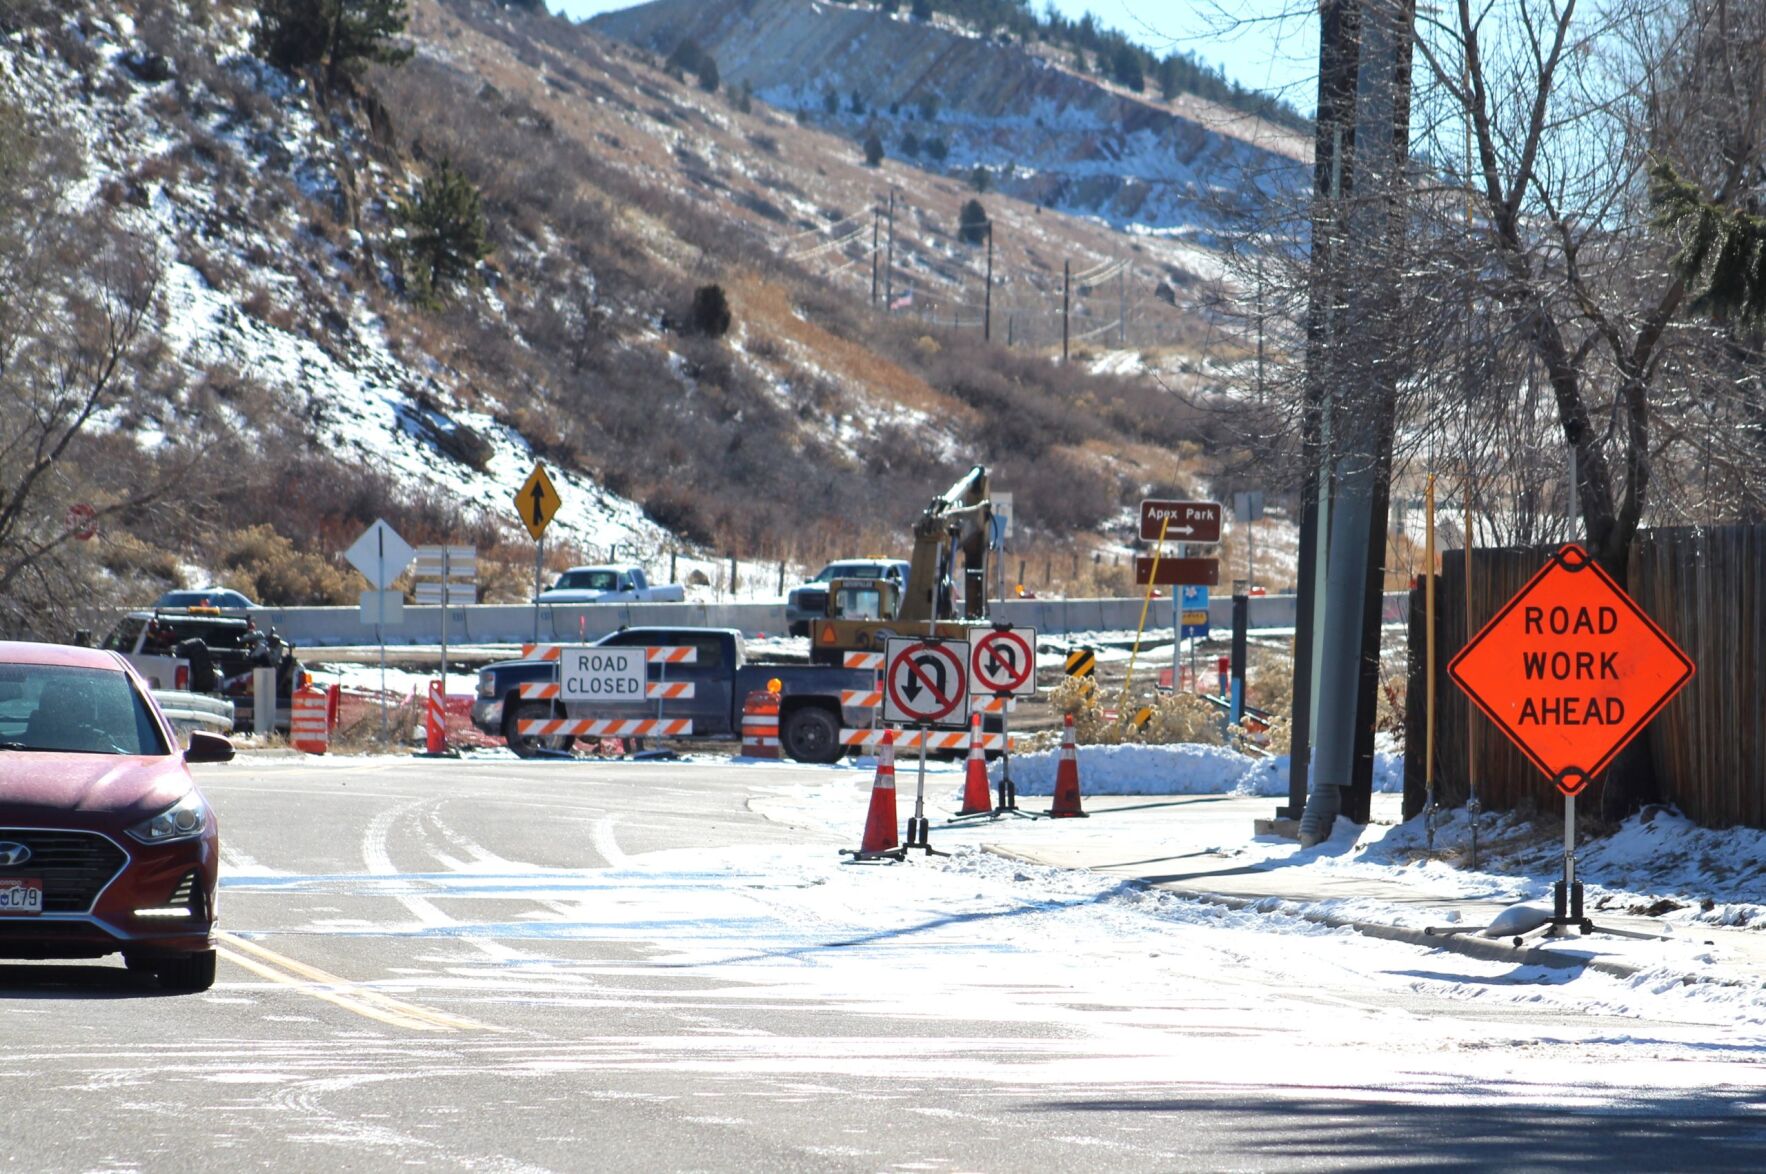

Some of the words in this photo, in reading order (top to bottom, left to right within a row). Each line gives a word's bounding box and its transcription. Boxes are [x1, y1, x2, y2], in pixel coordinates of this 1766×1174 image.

[1148, 507, 1178, 520] Apex
[1186, 508, 1214, 520] Park
[1525, 606, 1618, 635] ROAD
[578, 656, 628, 671] ROAD
[1523, 651, 1619, 680] WORK
[567, 677, 639, 693] CLOSED
[1518, 697, 1625, 725] AHEAD
[11, 889, 37, 906] C79
